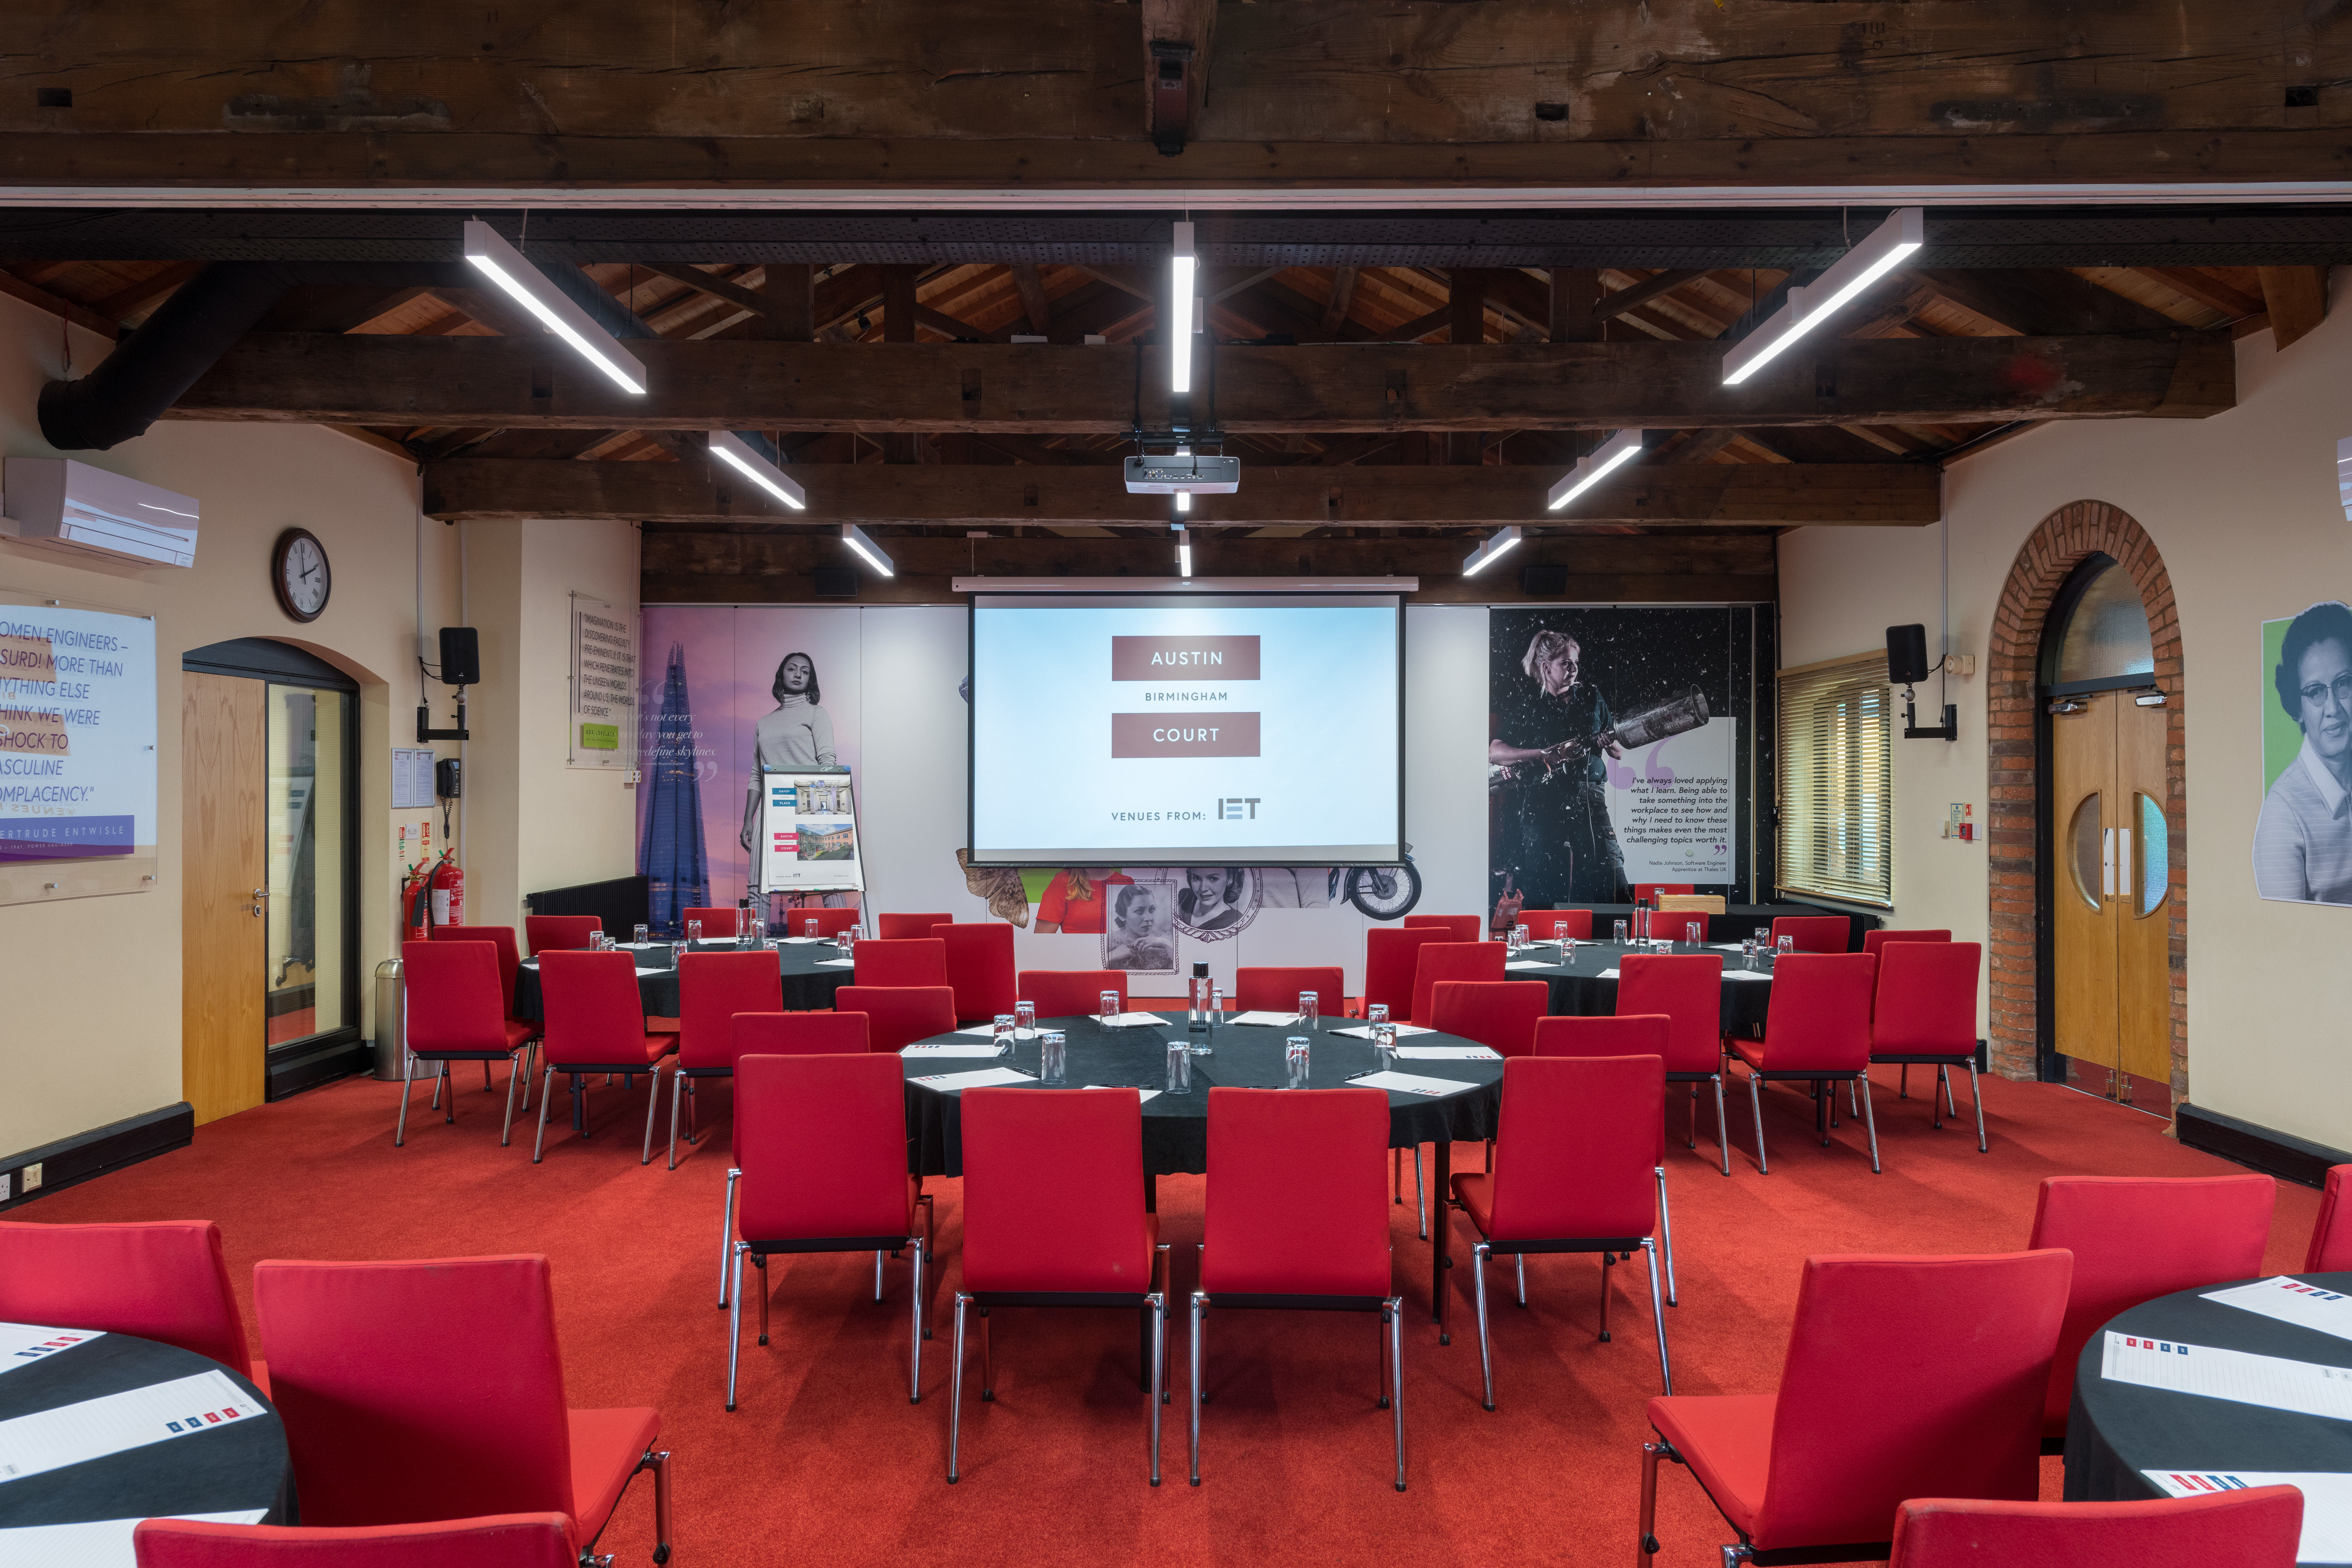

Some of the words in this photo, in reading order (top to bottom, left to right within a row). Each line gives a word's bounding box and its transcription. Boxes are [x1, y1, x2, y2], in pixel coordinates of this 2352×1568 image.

[614, 622, 618, 631] IS
[46, 628, 118, 651] ENGINEERS
[585, 629, 613, 644] DISCOVERING
[0, 649, 42, 668] SURD!
[47, 654, 85, 673] MORE
[89, 659, 123, 677] THAN
[617, 652, 621, 661] IT
[622, 653, 625, 662] IS
[626, 654, 636, 663] THAT
[1151, 652, 1221, 665] AUSTIN
[584, 659, 599, 670] WHICH
[600, 662, 624, 675] PENETRATES
[624, 668, 634, 677] INTO
[593, 677, 610, 687] UNSEEN
[610, 679, 627, 690] WORLDS
[60, 682, 90, 699] ELSE
[1146, 692, 1227, 701] BIRMINGHAM
[584, 690, 602, 701] AROUND
[619, 695, 635, 706] WORLDS
[38, 706, 60, 723] WE
[65, 708, 101, 725] WERE
[584, 705, 590, 714] OF
[668, 714, 696, 724] every
[51, 733, 68, 749] TO
[656, 731, 675, 742] you
[677, 731, 693, 742] get
[1154, 729, 1219, 742] COURT
[675, 746, 716, 759] skylines.
[0, 759, 64, 775] SCULINE
[1647, 777, 1671, 785] always
[1696, 777, 1727, 785] applying
[0, 786, 94, 802] MPLACENCY."
[1658, 797, 1696, 805] something
[1112, 812, 1160, 820] VENUES
[1167, 812, 1205, 820] FROM:
[1218, 798, 1261, 820] IET
[1633, 817, 1647, 825] why
[0, 828, 56, 839] ERTRUDE
[65, 826, 123, 837] ENTWISLE
[1624, 826, 1646, 835] things
[1627, 836, 1668, 844] challenging
